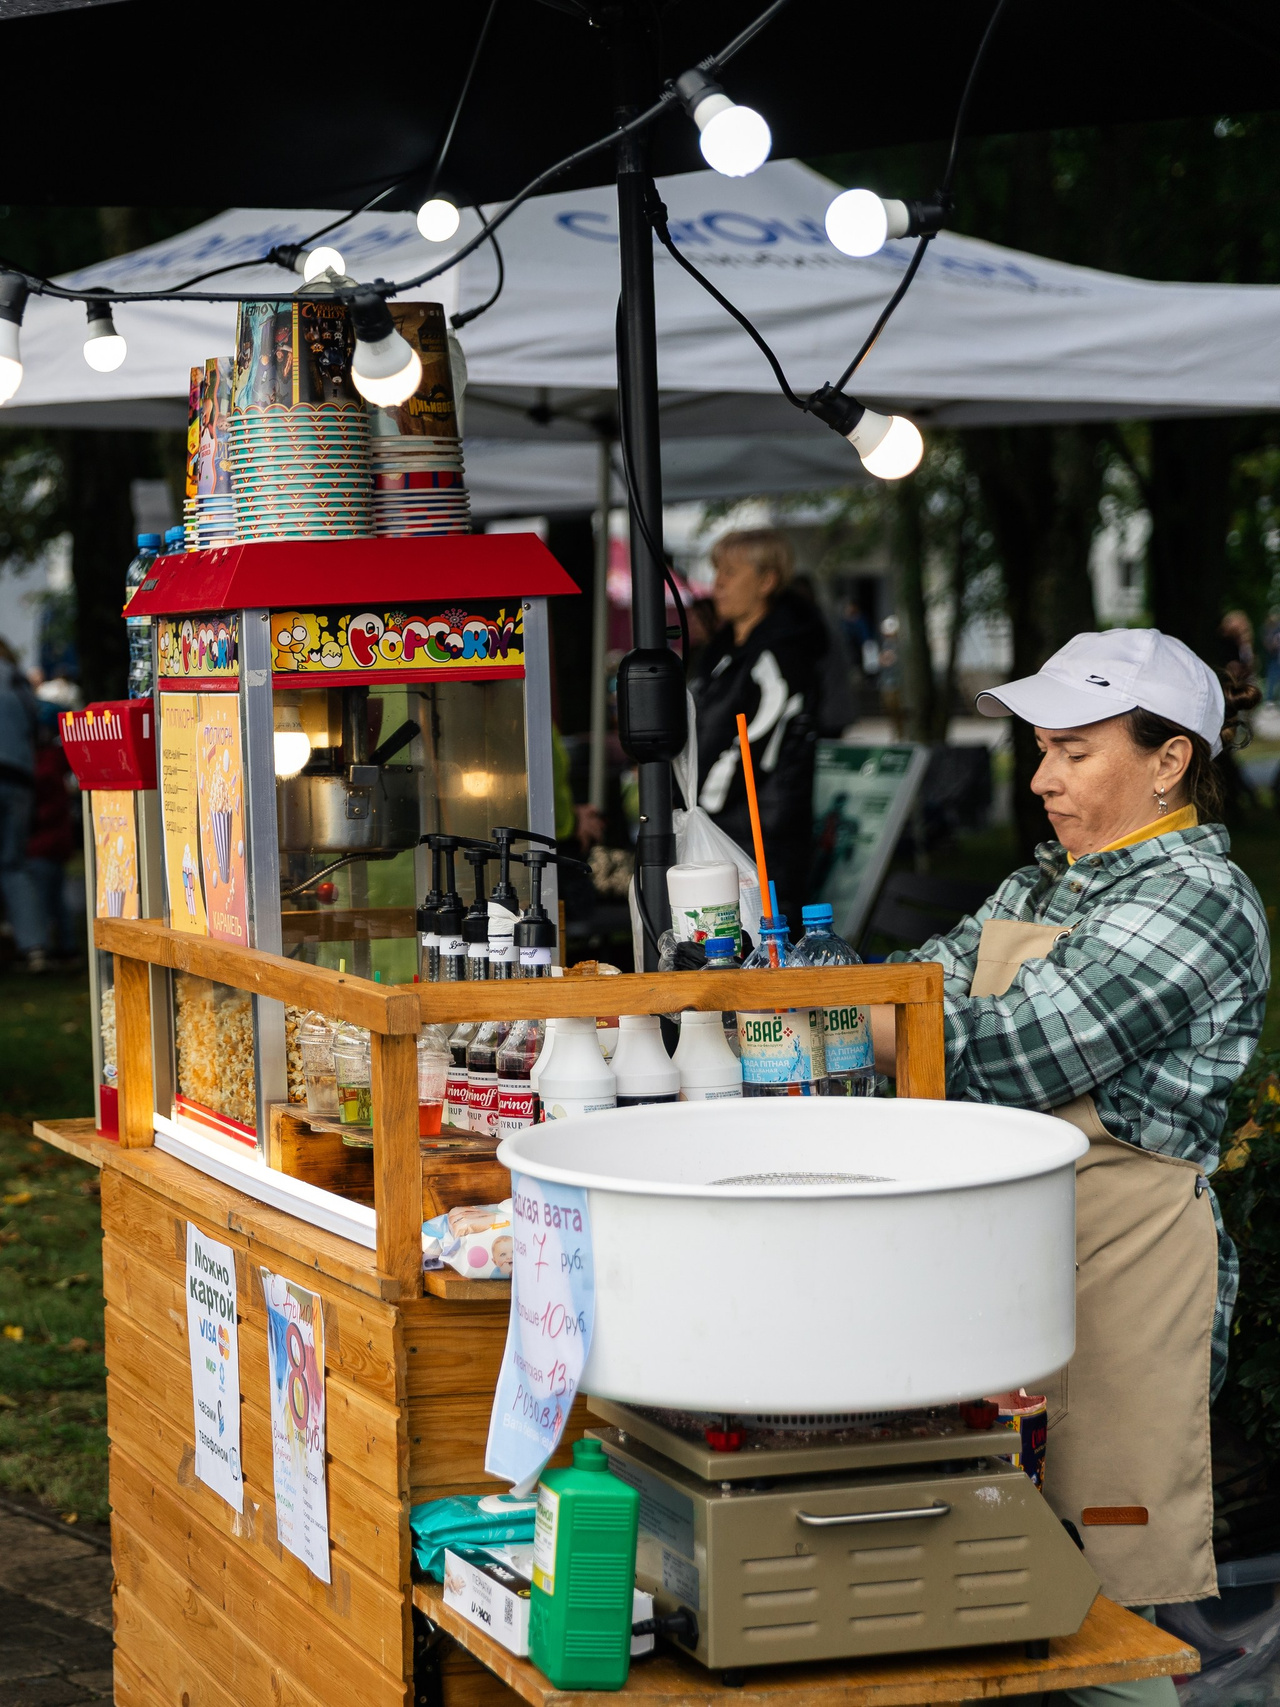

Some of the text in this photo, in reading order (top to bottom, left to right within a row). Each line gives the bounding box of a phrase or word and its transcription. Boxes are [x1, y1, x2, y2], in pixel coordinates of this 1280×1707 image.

[204, 726, 234, 746] ПОПКОРН
[212, 910, 242, 938] КАРАМЕЛЬ
[745, 1015, 783, 1042] СВАЁ
[500, 1120, 523, 1130] SYRUP
[543, 1202, 583, 1232] вата
[194, 1242, 230, 1286] Можно
[533, 1233, 549, 1282] 7
[560, 1248, 583, 1274] руб.
[190, 1275, 235, 1324] картой
[198, 1316, 217, 1346] VISA
[541, 1301, 566, 1338] 10
[565, 1311, 587, 1336] руб.
[286, 1322, 310, 1430] 8
[547, 1359, 567, 1397] 13
[198, 1399, 217, 1423] часами
[199, 1429, 229, 1463] телефоном
[306, 1424, 322, 1453] руб.
